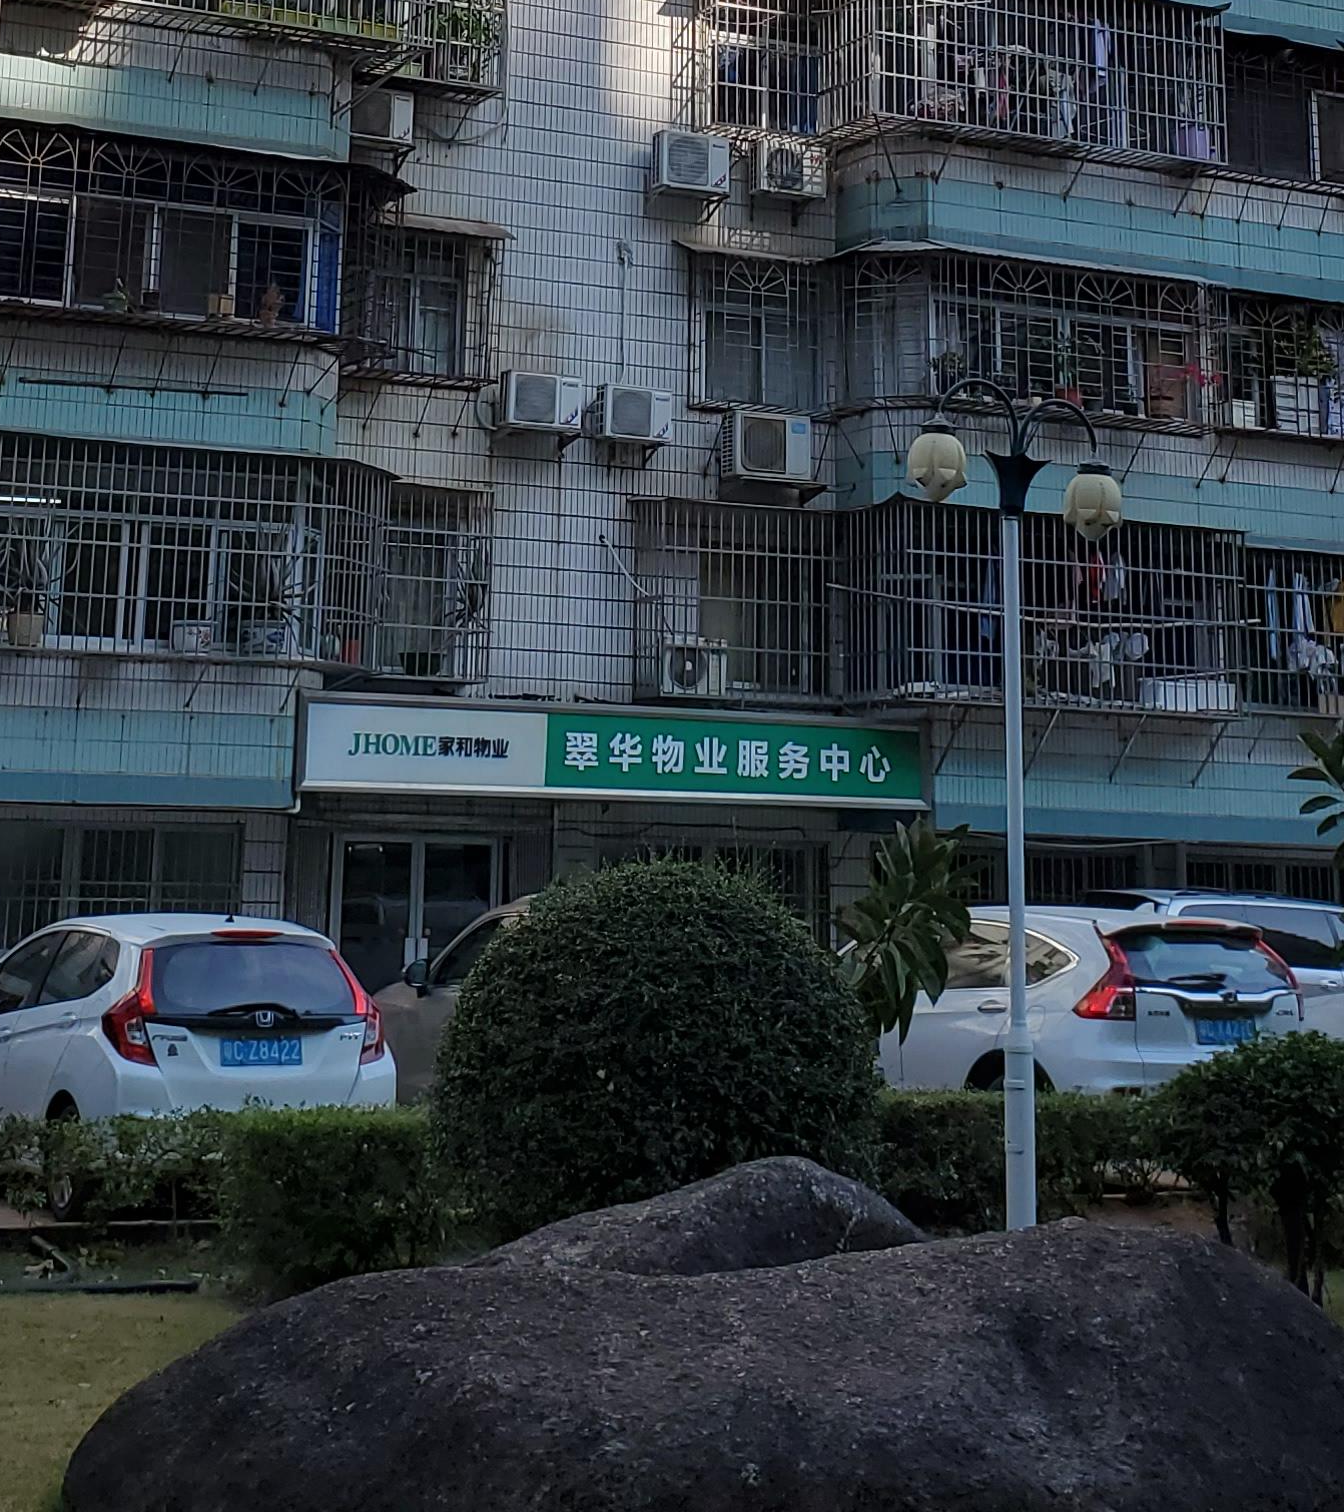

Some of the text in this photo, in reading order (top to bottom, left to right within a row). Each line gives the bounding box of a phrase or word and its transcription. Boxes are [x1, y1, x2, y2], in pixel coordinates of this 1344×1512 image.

[564, 731, 891, 784] 翠华物业服务中心
